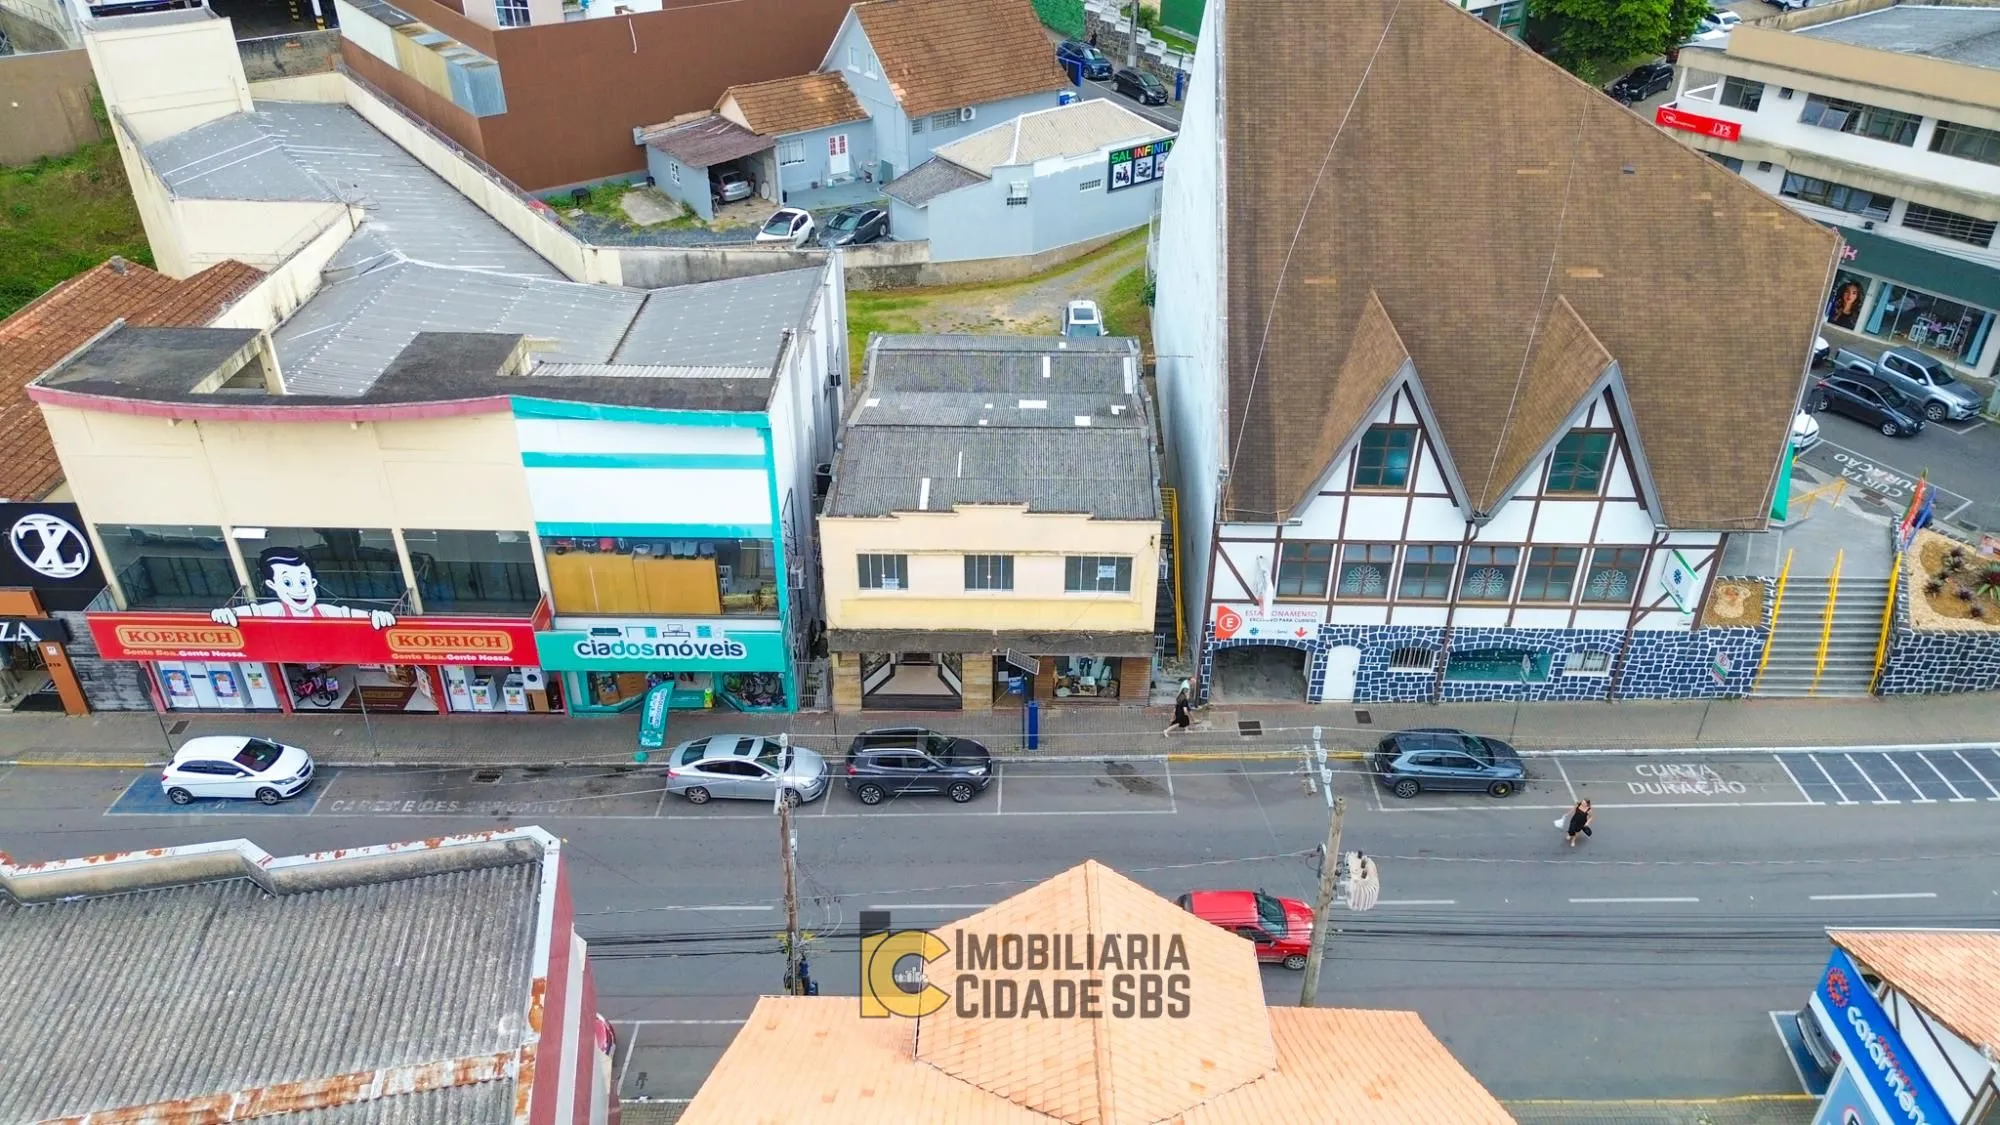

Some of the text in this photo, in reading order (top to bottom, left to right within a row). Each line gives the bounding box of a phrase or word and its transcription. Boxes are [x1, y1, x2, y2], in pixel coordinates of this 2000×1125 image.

[1111, 151, 1132, 164] SAL
[1841, 466, 1903, 498] CURTA
[127, 631, 233, 643] KOERICH
[396, 635, 502, 647] KOERICH
[577, 640, 744, 657] ciadosmóveis
[1635, 764, 1721, 781] CURTA
[1626, 780, 1747, 796] DURAÇÃO
